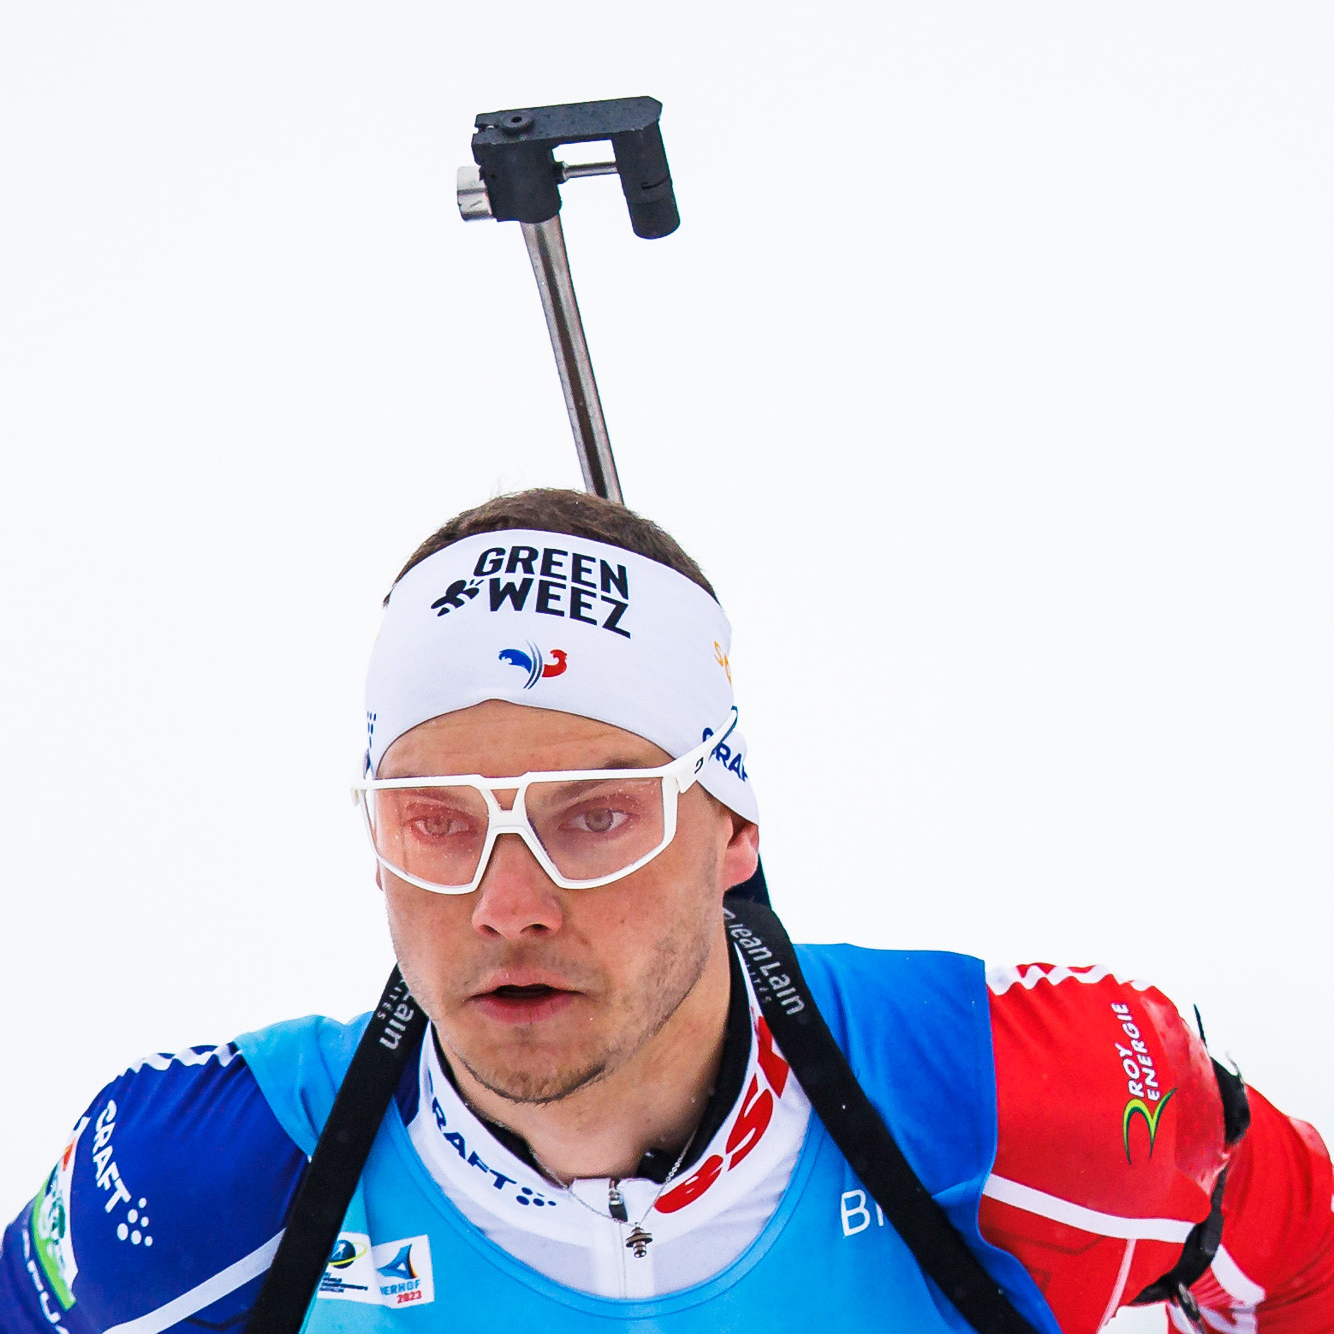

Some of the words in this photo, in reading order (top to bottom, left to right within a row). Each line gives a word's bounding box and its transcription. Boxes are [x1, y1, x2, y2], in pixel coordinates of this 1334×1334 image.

[472, 545, 630, 600] GREEN
[488, 577, 632, 639] WEEZ
[1110, 1002, 1161, 1102] ENERGIE
[1114, 1042, 1146, 1098] ROY
[92, 1099, 131, 1214] CRAFT
[428, 1070, 517, 1190] RAFT
[397, 1290, 423, 1304] 2023
